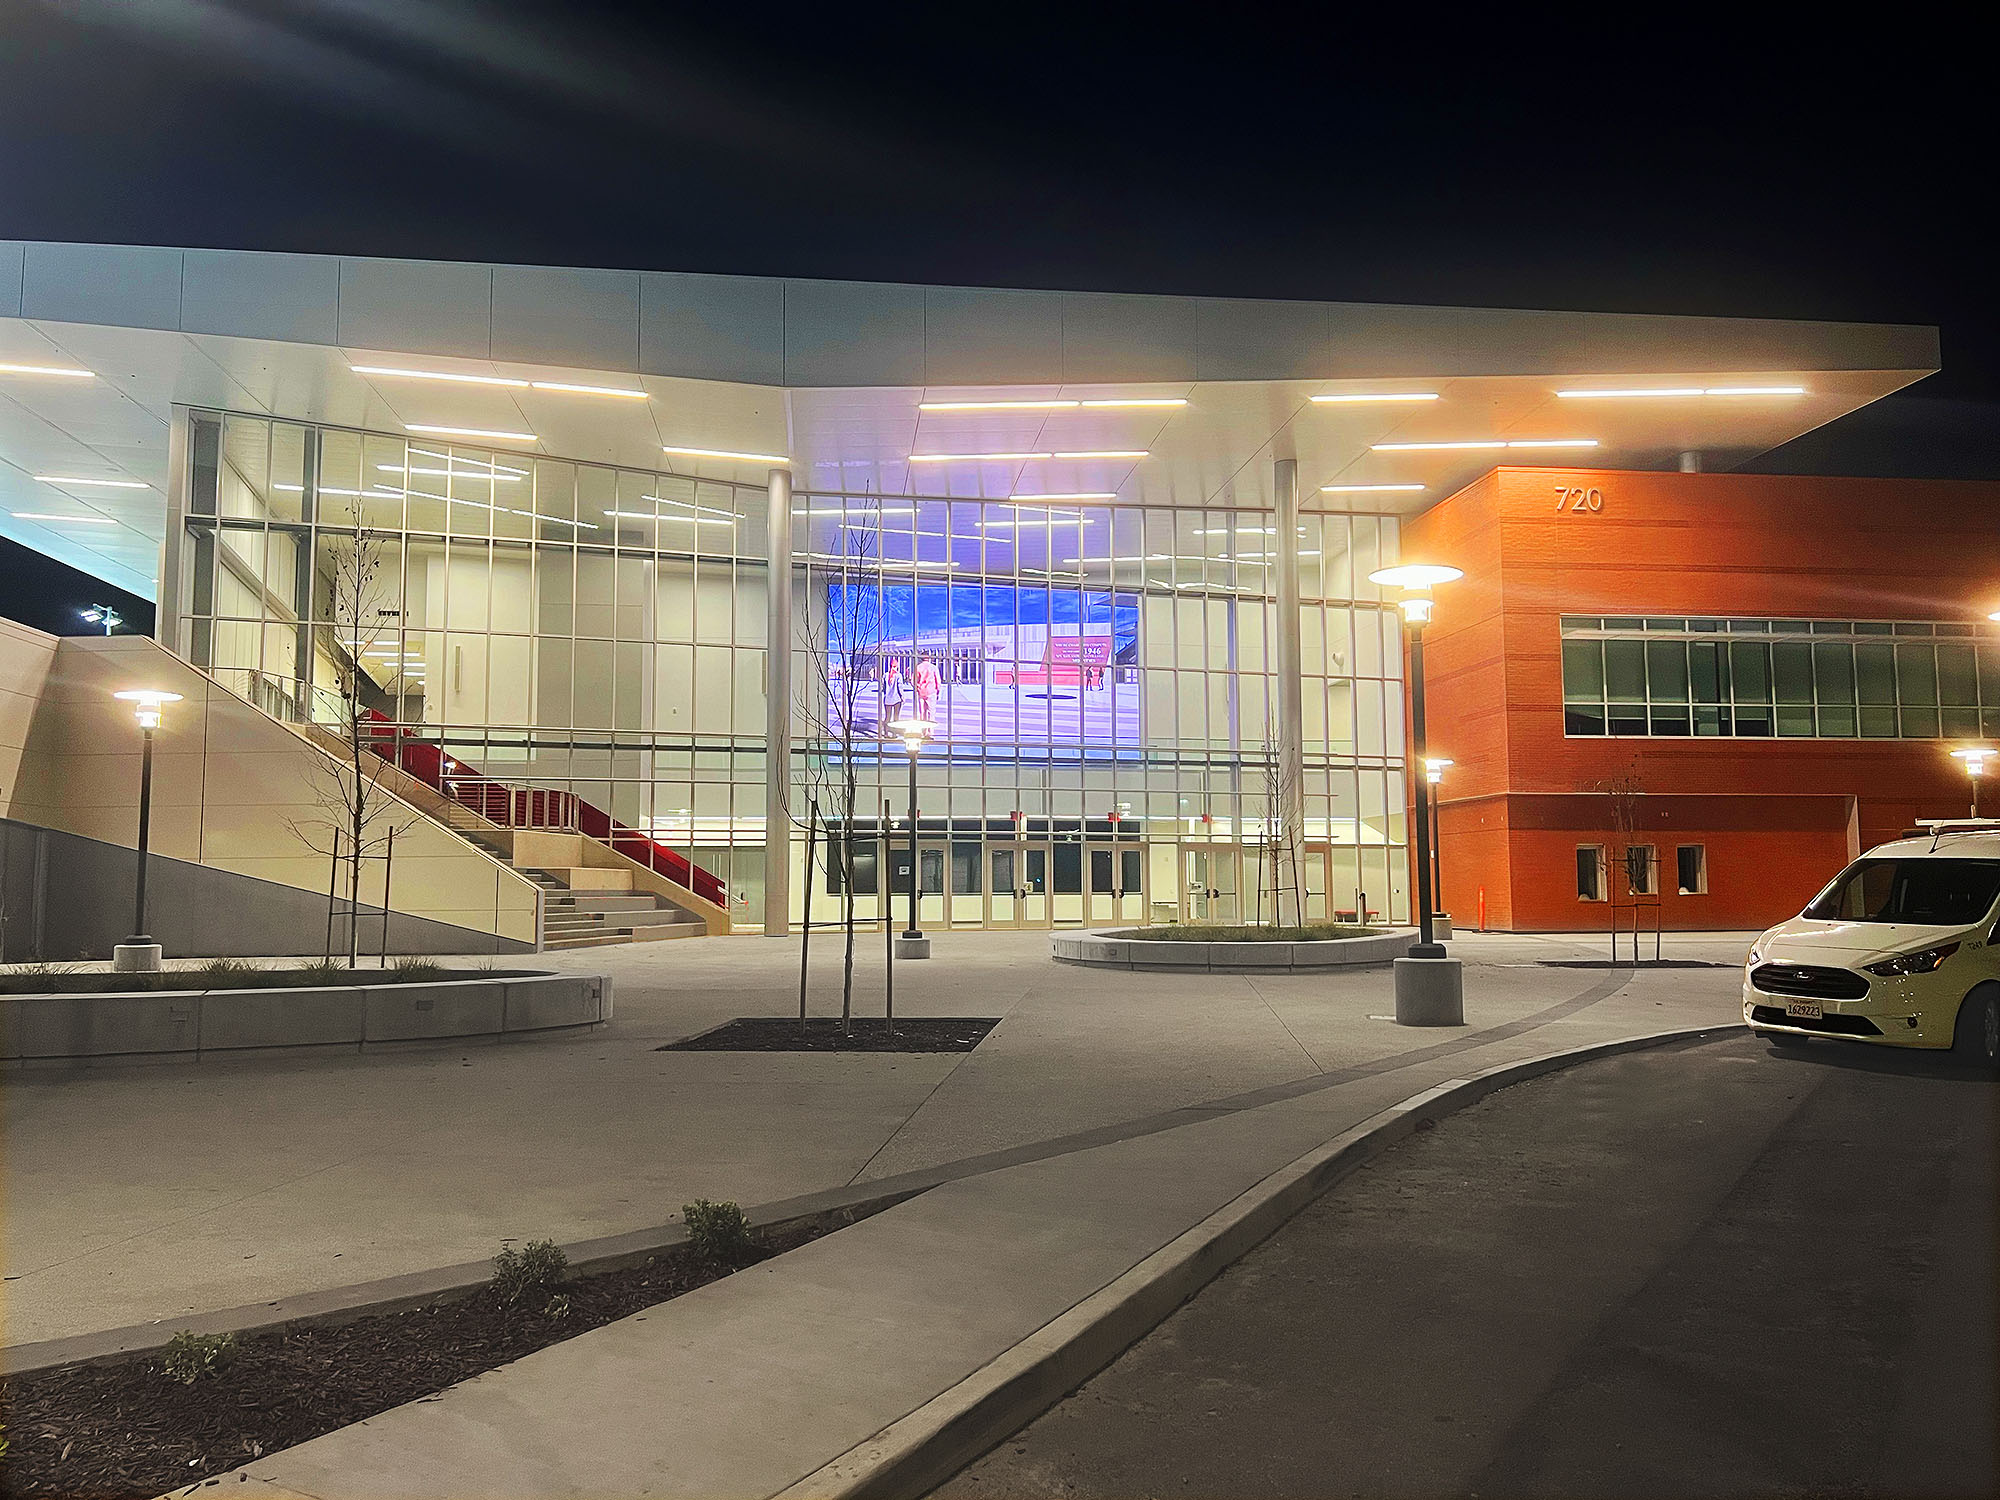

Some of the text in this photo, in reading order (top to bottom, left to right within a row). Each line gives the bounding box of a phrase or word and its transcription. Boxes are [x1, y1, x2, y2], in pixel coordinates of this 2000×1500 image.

[1555, 487, 1602, 511] 720
[1084, 647, 1102, 655] 1946
[1788, 1004, 1820, 1016] 1629223
